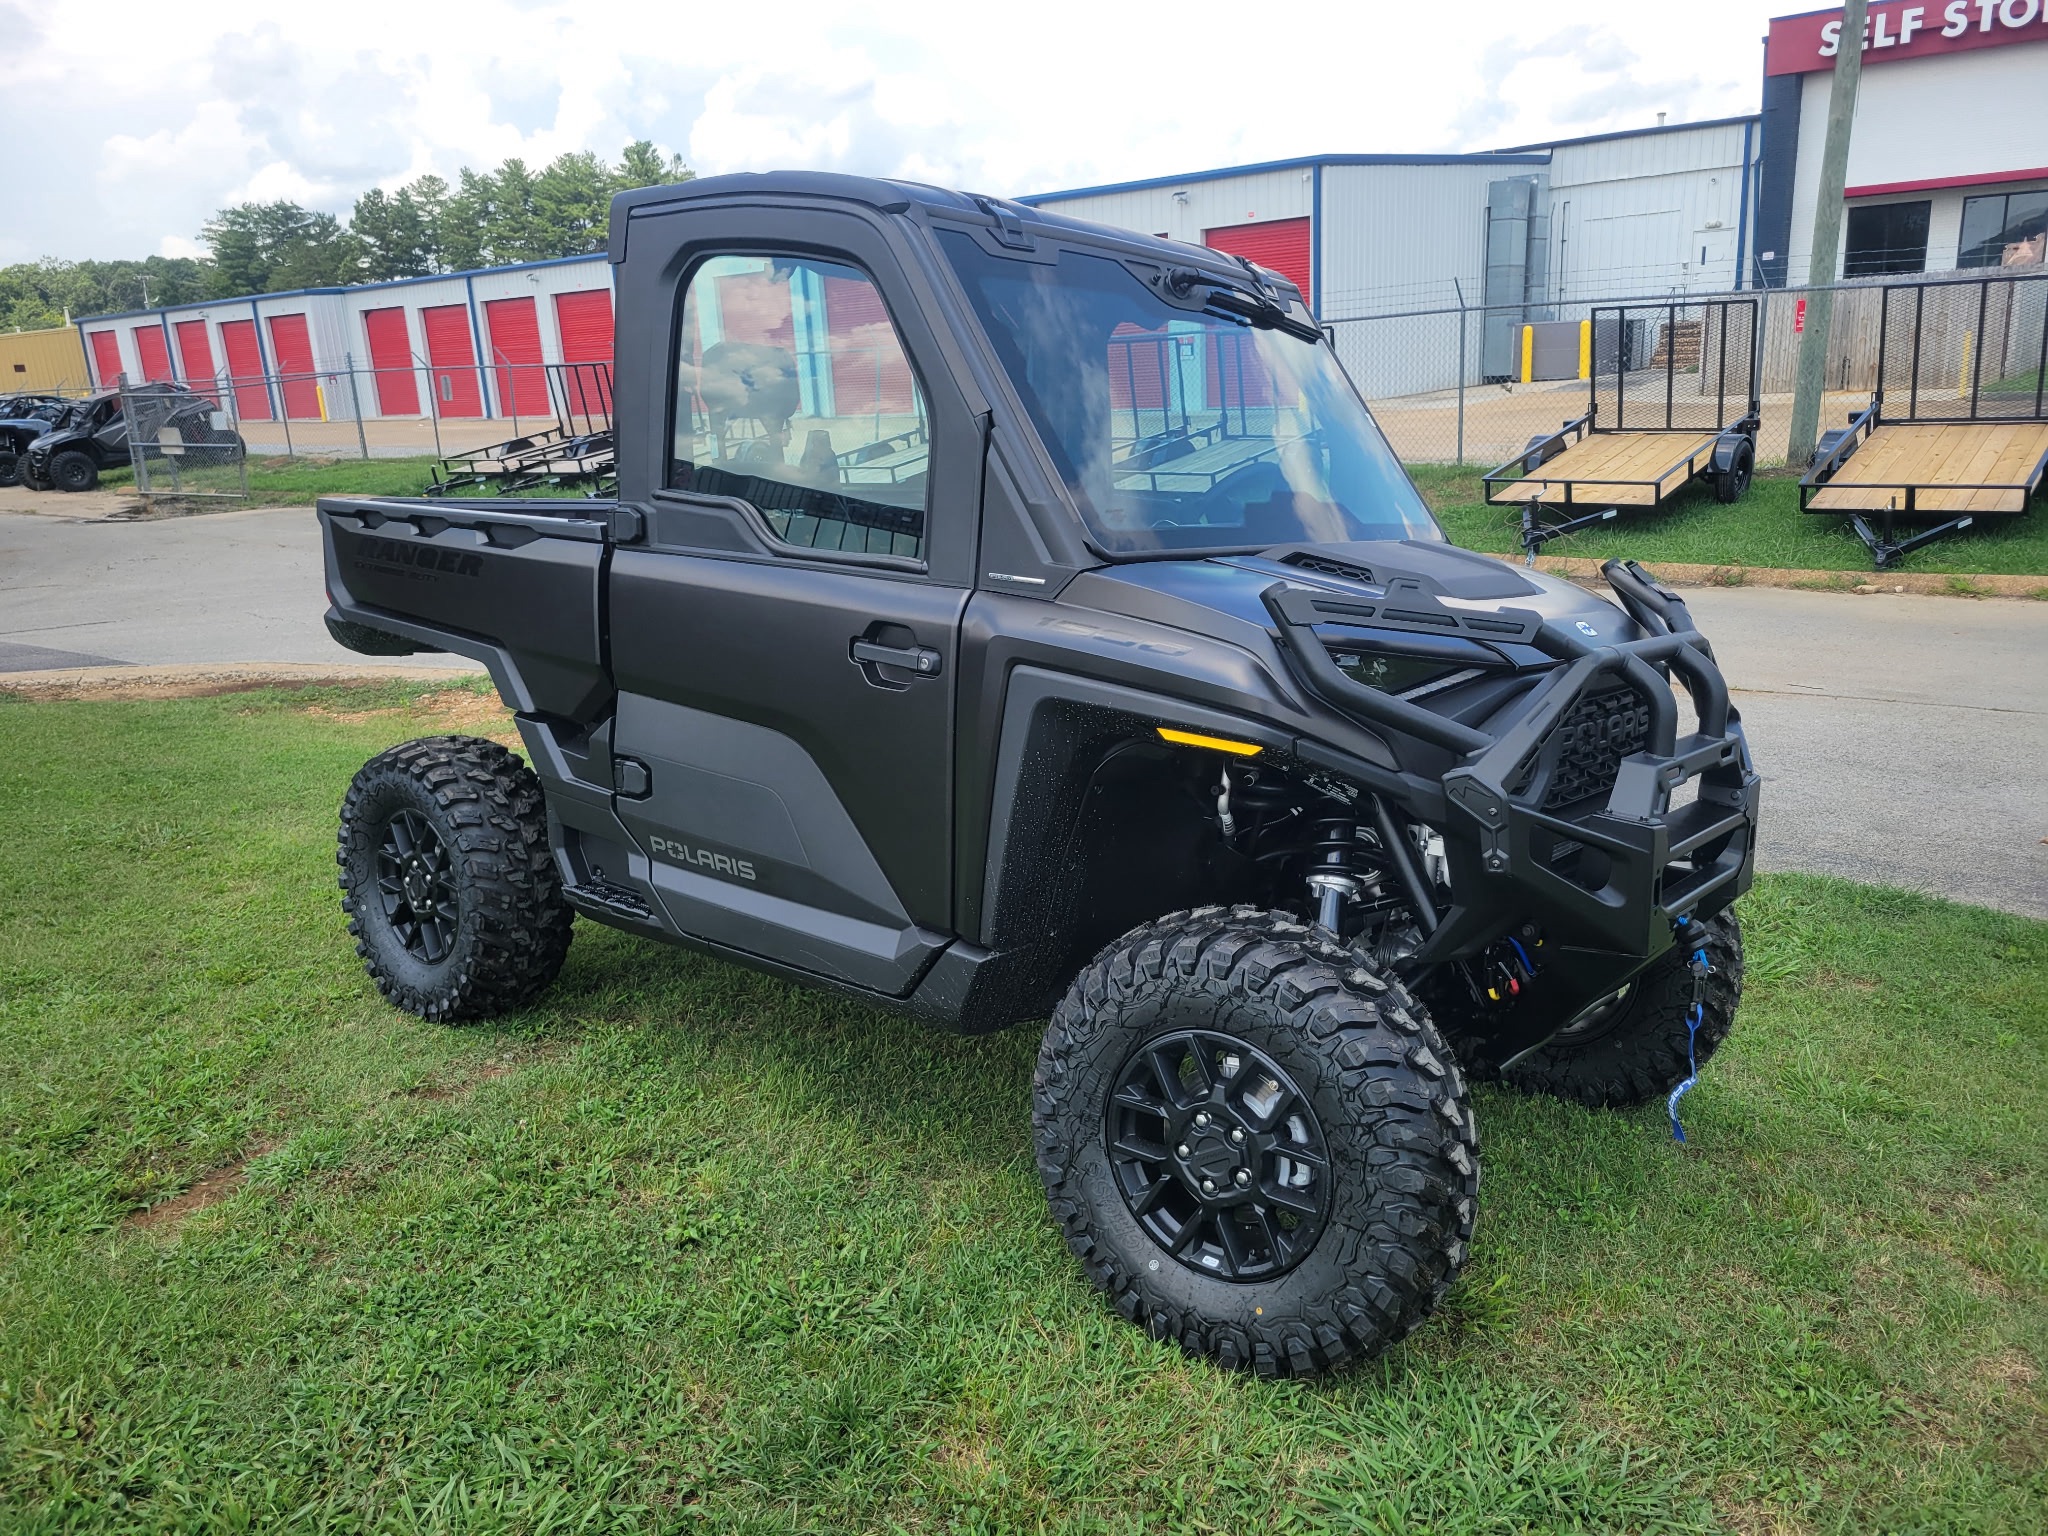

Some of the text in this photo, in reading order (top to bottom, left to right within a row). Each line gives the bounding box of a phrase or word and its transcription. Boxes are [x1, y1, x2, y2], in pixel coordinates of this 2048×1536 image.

[1941, 0, 2048, 38] STO
[357, 536, 485, 578] RANGER
[1559, 705, 1649, 754] POLARIS
[649, 835, 757, 881] POLARIS
